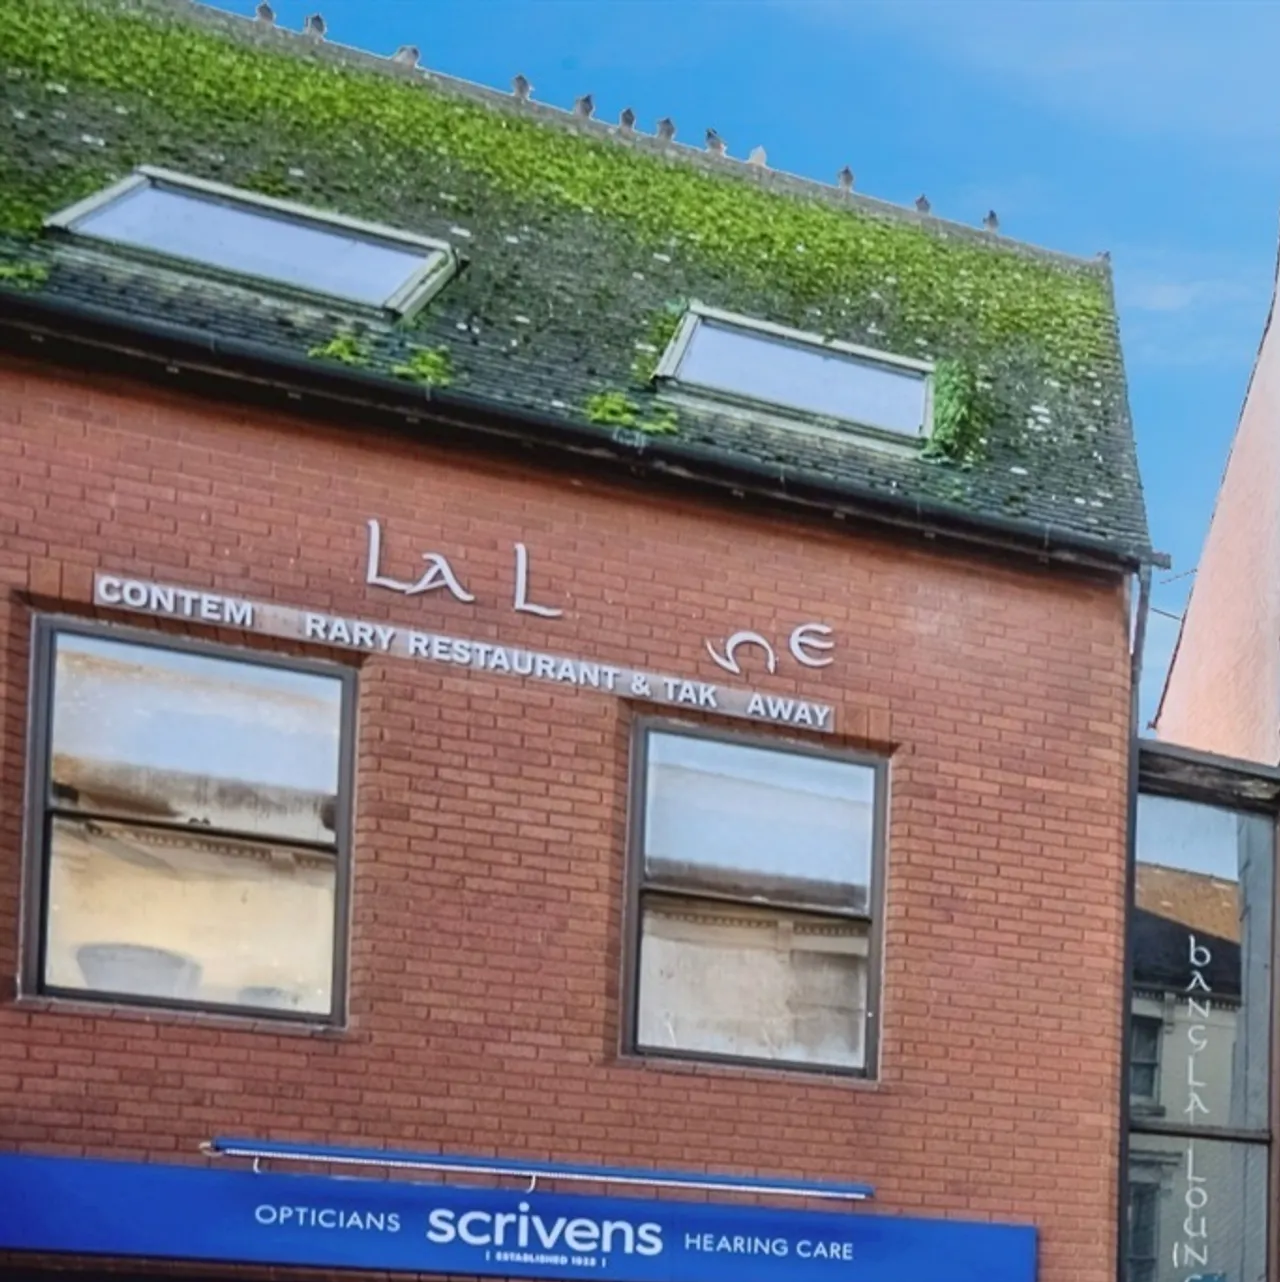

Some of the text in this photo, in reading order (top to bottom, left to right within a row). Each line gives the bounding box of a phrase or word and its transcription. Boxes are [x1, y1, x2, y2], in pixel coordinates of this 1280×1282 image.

[408, 631, 620, 690] RESTAURANT
[630, 674, 651, 697] &
[255, 1204, 400, 1232] OPTICIANS
[426, 1202, 662, 1256] scrivens
[496, 1252, 568, 1266] ESTABLISHED
[685, 1233, 853, 1260] HEARING CARE
